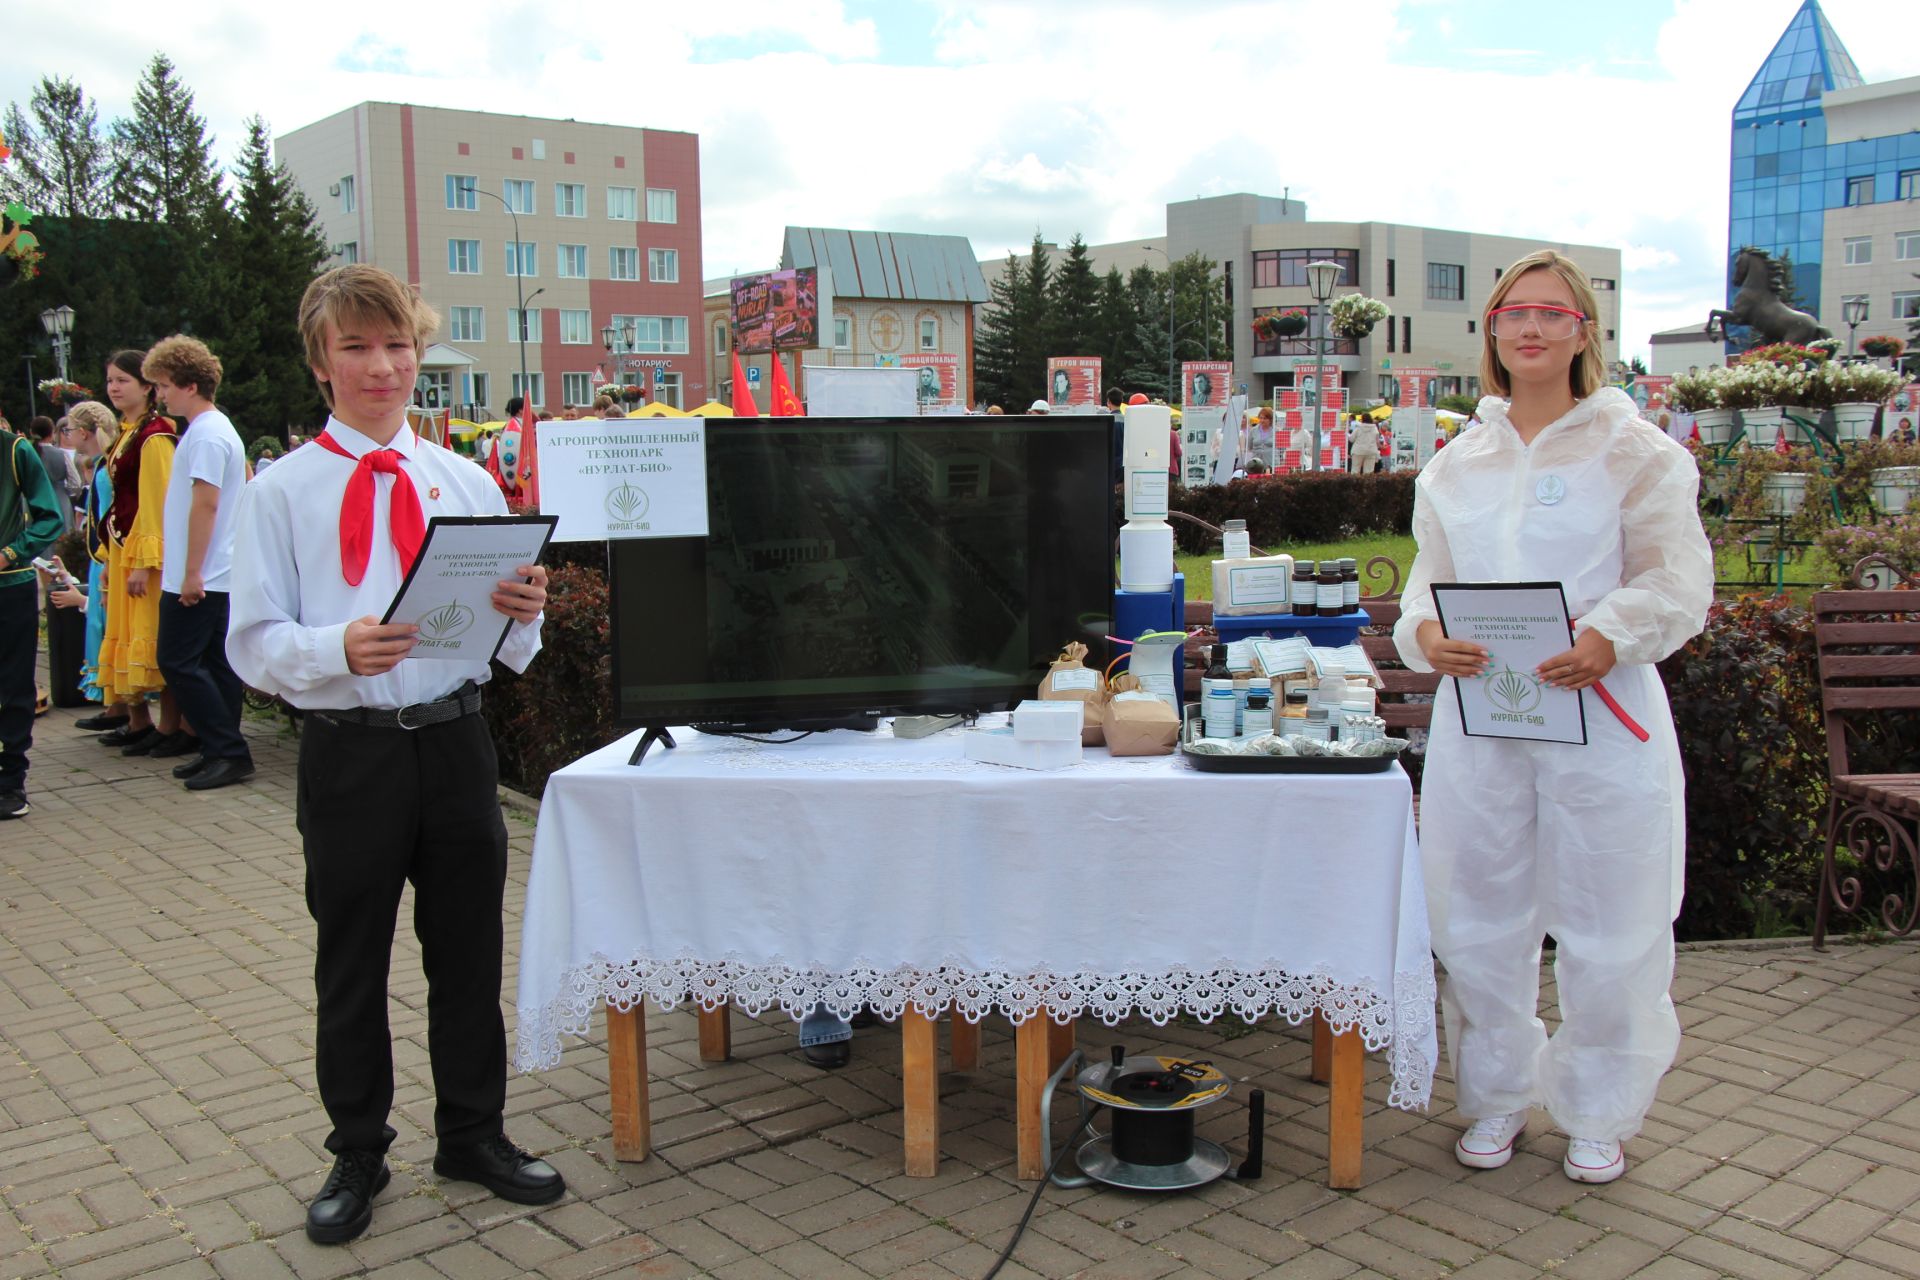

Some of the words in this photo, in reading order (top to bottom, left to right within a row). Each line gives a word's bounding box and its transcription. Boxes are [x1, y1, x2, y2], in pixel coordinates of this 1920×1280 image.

[736, 284, 768, 305] OFF-ROAD
[628, 359, 673, 368] НОТАРИУС
[548, 431, 700, 447] АГРОПРОМЫШЛЕННЫЙ
[586, 447, 664, 459] ТЕХНОПАРК
[578, 463, 672, 475] «НУРЛАТ-БИО»
[607, 522, 650, 531] НУРЛАТ-БИО
[432, 551, 532, 561] АГРОПРОМЫШЛЕННЫЙ
[1452, 615, 1559, 623] АГРОПРОМЫШЛЕННЫЙ
[1470, 633, 1536, 641] «НУРЛАТ-БИО»
[416, 639, 462, 648] РЛАТ-БИО
[1490, 712, 1545, 725] НУРЛАТ-БИО
